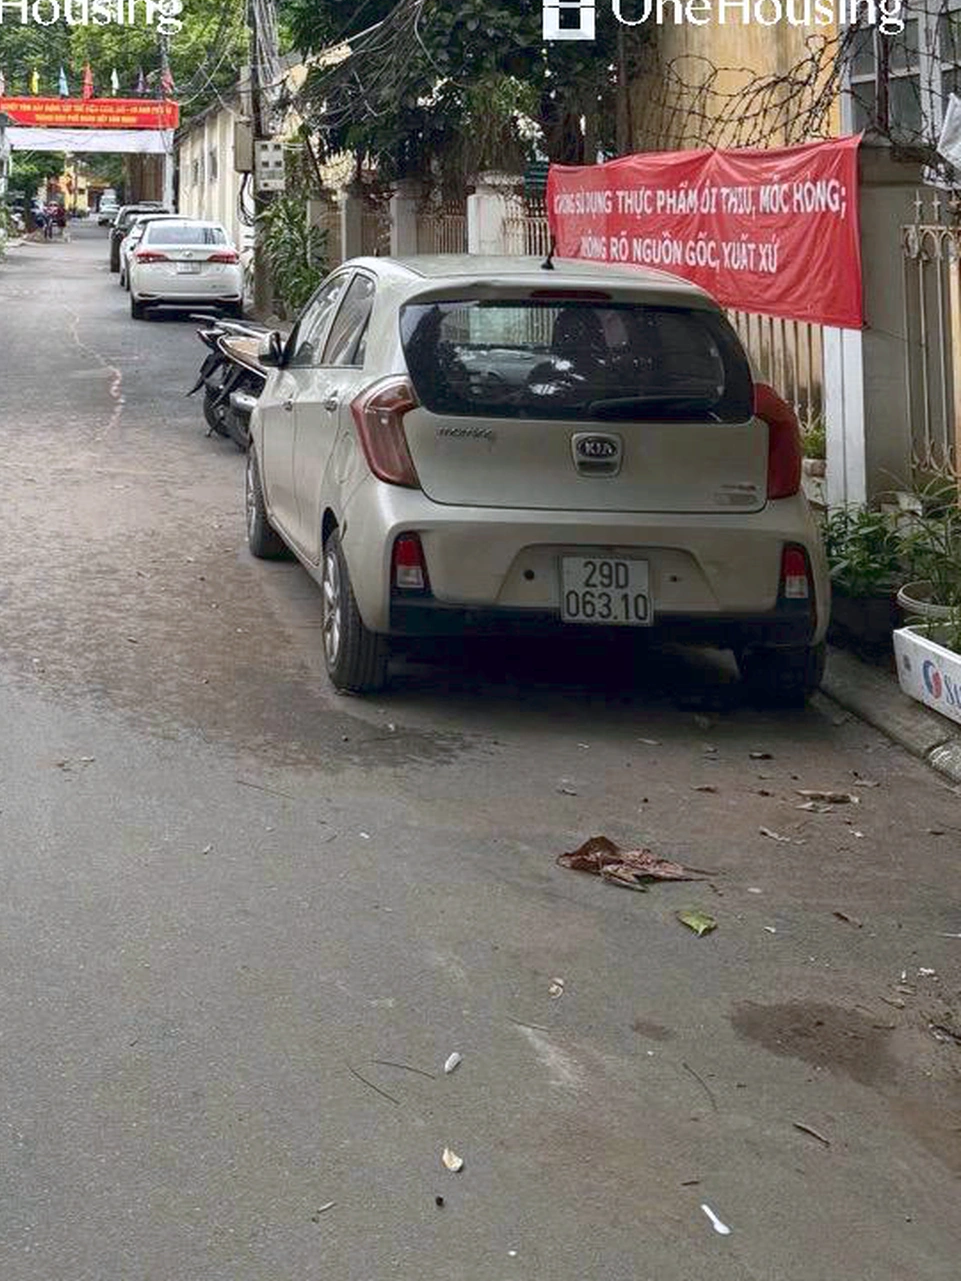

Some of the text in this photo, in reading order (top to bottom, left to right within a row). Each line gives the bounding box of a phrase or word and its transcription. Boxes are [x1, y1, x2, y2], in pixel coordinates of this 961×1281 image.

[616, 186, 652, 219] THỰC
[656, 181, 698, 214] PHẨM
[721, 185, 756, 220] THIU,
[759, 174, 790, 214] MỐC
[610, 231, 628, 261] RÕ
[633, 230, 682, 265] NGUỒN
[721, 233, 756, 271] XUẤT
[759, 234, 779, 274] XỨ
[584, 441, 613, 455] KIA
[583, 561, 630, 589] 29D
[566, 590, 649, 621] 063.10
